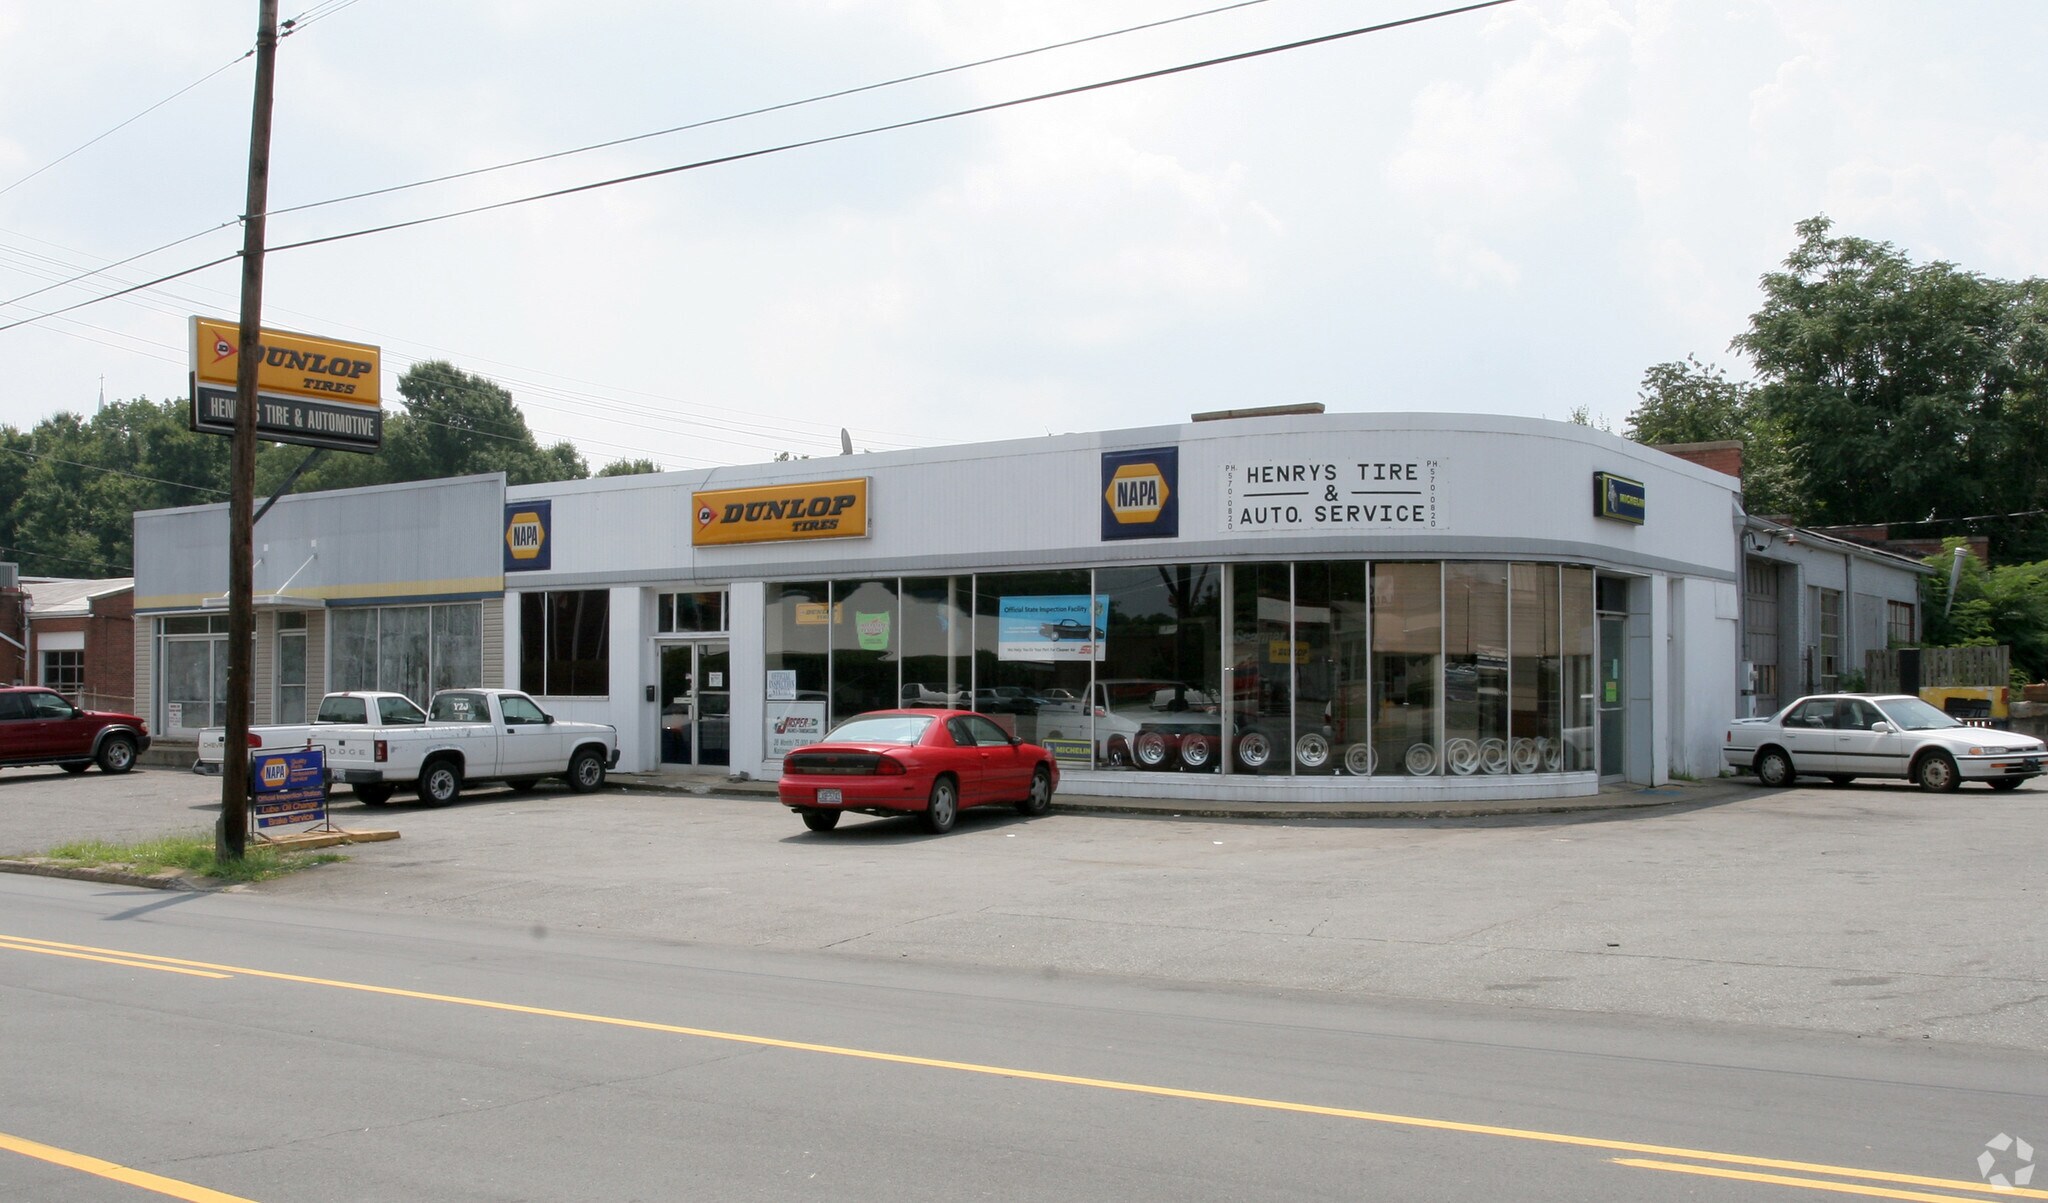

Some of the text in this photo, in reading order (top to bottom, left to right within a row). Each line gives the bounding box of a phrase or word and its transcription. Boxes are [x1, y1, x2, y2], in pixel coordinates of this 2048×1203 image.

[303, 378, 357, 395] TIRES
[264, 403, 290, 426] TIRE
[294, 408, 304, 427] &
[307, 411, 375, 437] AUTOMOTIVE
[1357, 463, 1418, 481] TIRE
[1116, 479, 1158, 508] NAPA
[1324, 484, 1339, 502] &
[720, 495, 857, 524] DUNLOP
[1240, 505, 1425, 525] AUTO. SERVICE
[792, 519, 839, 532] TIRES
[513, 525, 538, 546] NAPA
[1068, 605, 1087, 613] Facility
[1055, 746, 1091, 754] MICHELIN
[266, 766, 285, 779] NAPA
[292, 801, 317, 810] Change
[268, 814, 314, 825] Brake Service
